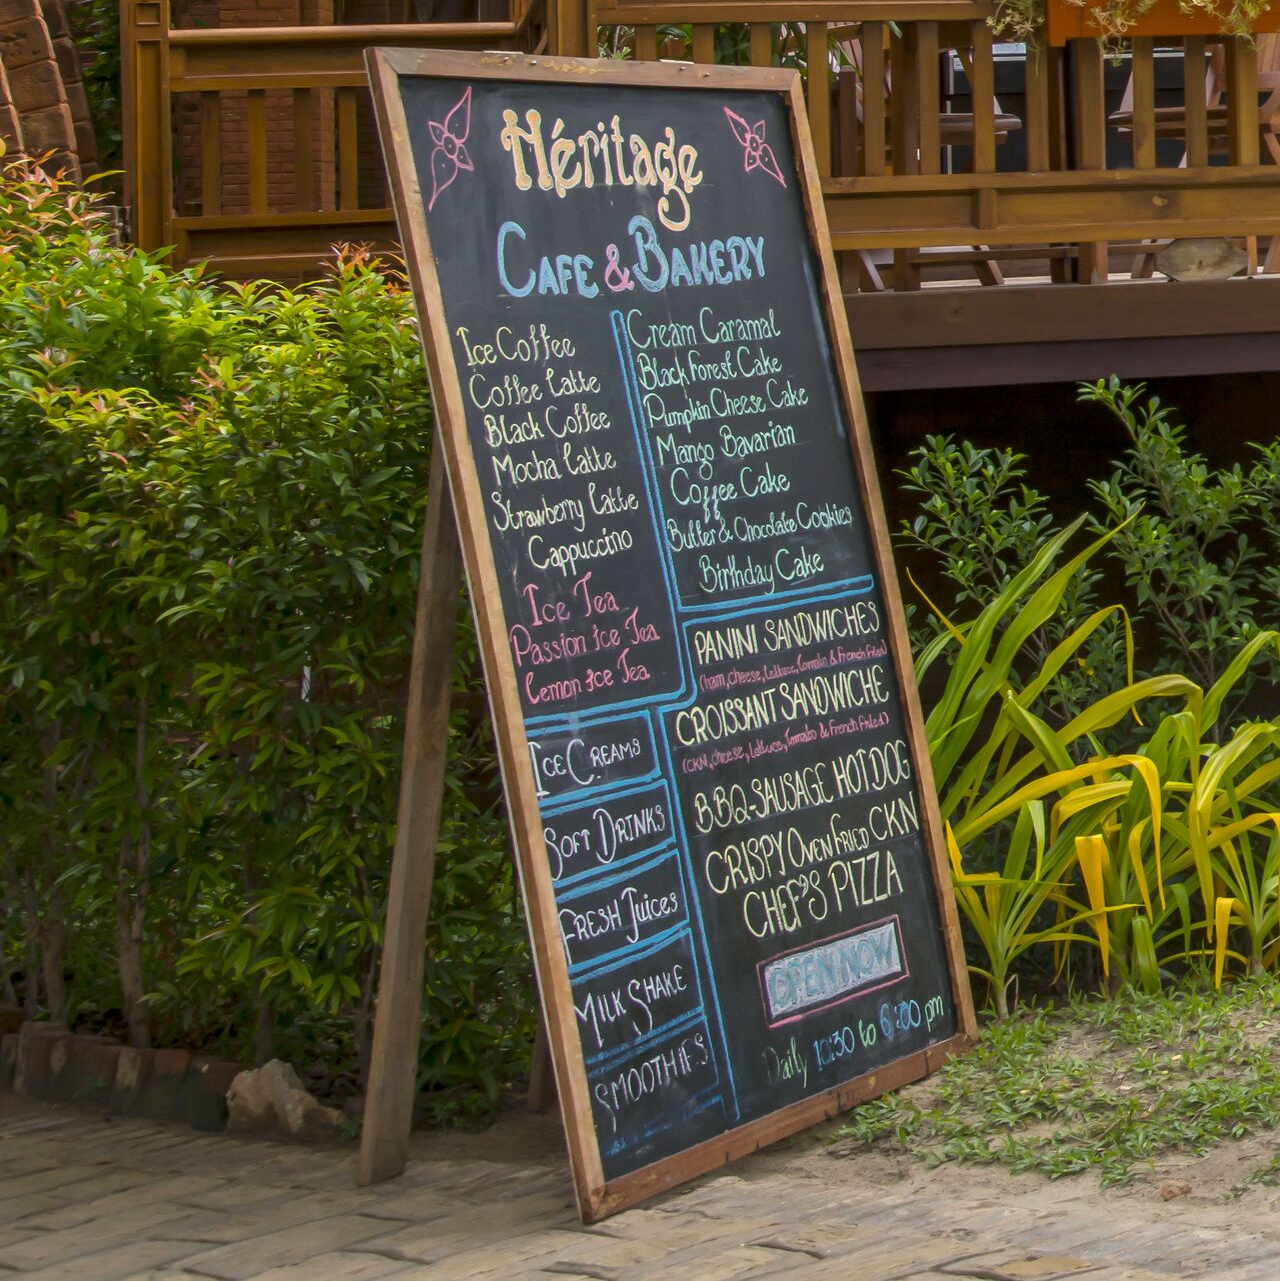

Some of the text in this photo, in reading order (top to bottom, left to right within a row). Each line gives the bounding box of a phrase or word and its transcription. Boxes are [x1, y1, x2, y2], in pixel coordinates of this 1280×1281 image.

[605, 243, 635, 292] &
[628, 214, 766, 293] BAKERY
[456, 323, 576, 366] Ice Coffee
[627, 308, 698, 349] Cream
[469, 368, 600, 409] Coffee Latte
[636, 345, 783, 391] Black Forest Cake
[484, 403, 611, 448] Black Coffee
[642, 378, 809, 434] Pumpkin Cheese Cake
[492, 442, 617, 486] Mocha Latte
[656, 421, 796, 480] Mango Bavarian
[491, 482, 639, 532] Strawberry Latte
[671, 462, 791, 524] Coffee Cake
[718, 518, 735, 543] &
[734, 511, 798, 542] Chocolate
[796, 502, 853, 530] Cookies
[528, 528, 633, 577] Cappuccino
[699, 546, 824, 595] Birthday Cake
[522, 571, 620, 626] Ice Tea
[509, 624, 586, 668] Passion
[624, 606, 661, 645] Tea
[694, 601, 880, 665] PANINI SANDWICHES
[526, 671, 582, 704] Lemon
[617, 647, 651, 684] Tea
[676, 664, 890, 746] CROISSANT SANDWICHE
[544, 804, 666, 881] SOFT DRINKS
[705, 830, 786, 896] CRISPY
[869, 790, 920, 841] CKN
[828, 850, 904, 912] PIZZA
[559, 899, 622, 965] FRESH
[769, 932, 896, 1005] OPEN NOW
[574, 964, 687, 1048] MILK SHAKE
[762, 1037, 807, 1088] Daily
[813, 1026, 855, 1072] 10:30
[859, 1019, 877, 1048] to
[924, 995, 944, 1032] pm
